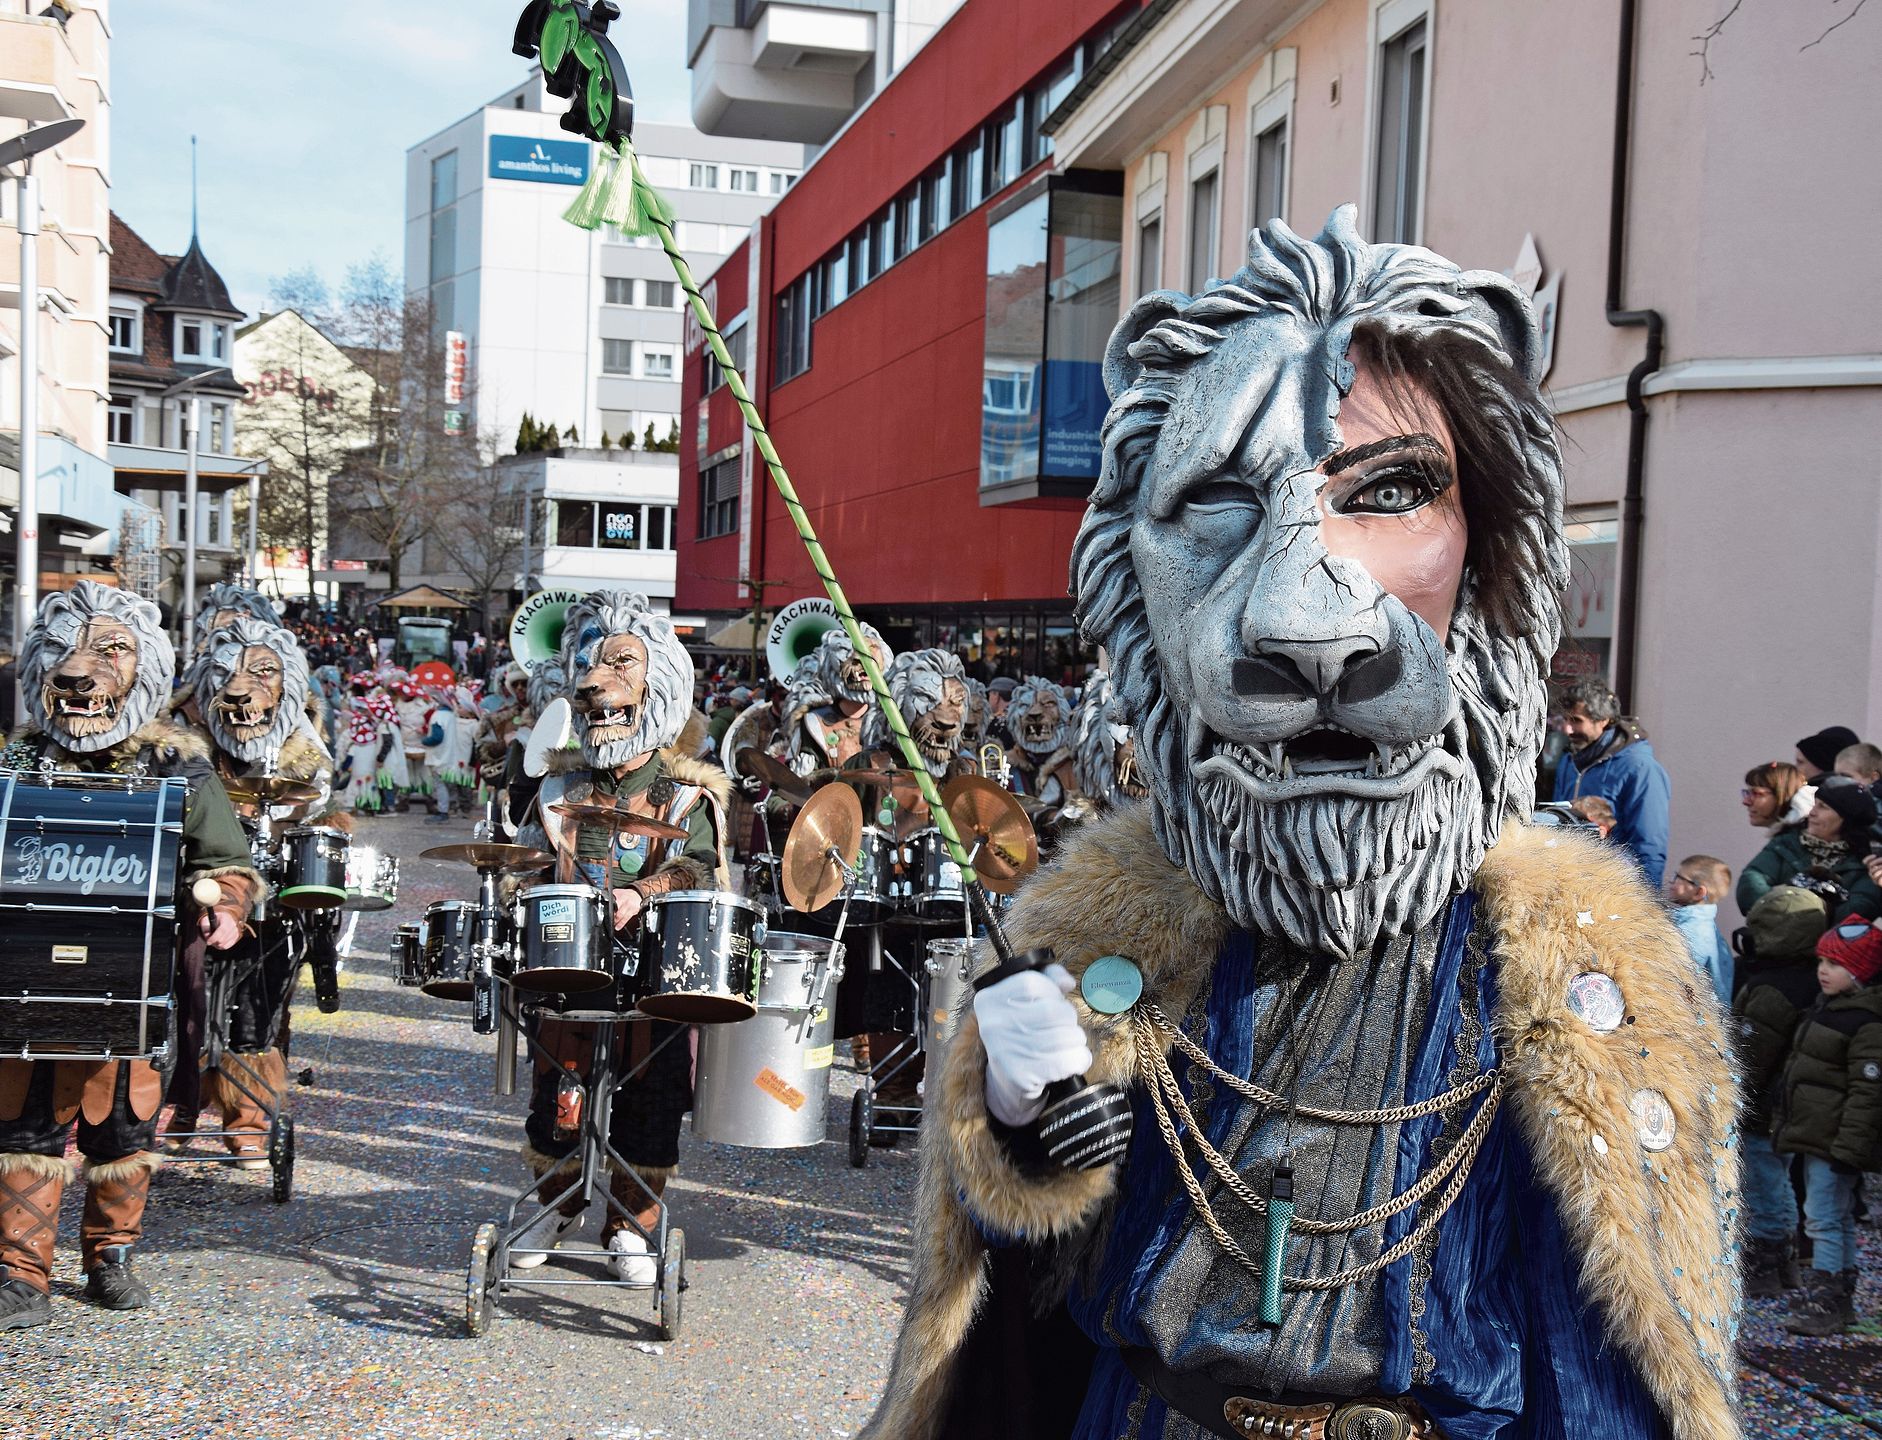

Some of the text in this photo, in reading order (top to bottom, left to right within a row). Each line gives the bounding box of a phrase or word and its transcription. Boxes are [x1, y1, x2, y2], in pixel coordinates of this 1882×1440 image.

[498, 160, 582, 178] amanthos living
[1047, 453, 1091, 467] imaging
[606, 530, 634, 539] GYM
[43, 842, 147, 895] Bigler
[541, 901, 562, 912] Dich
